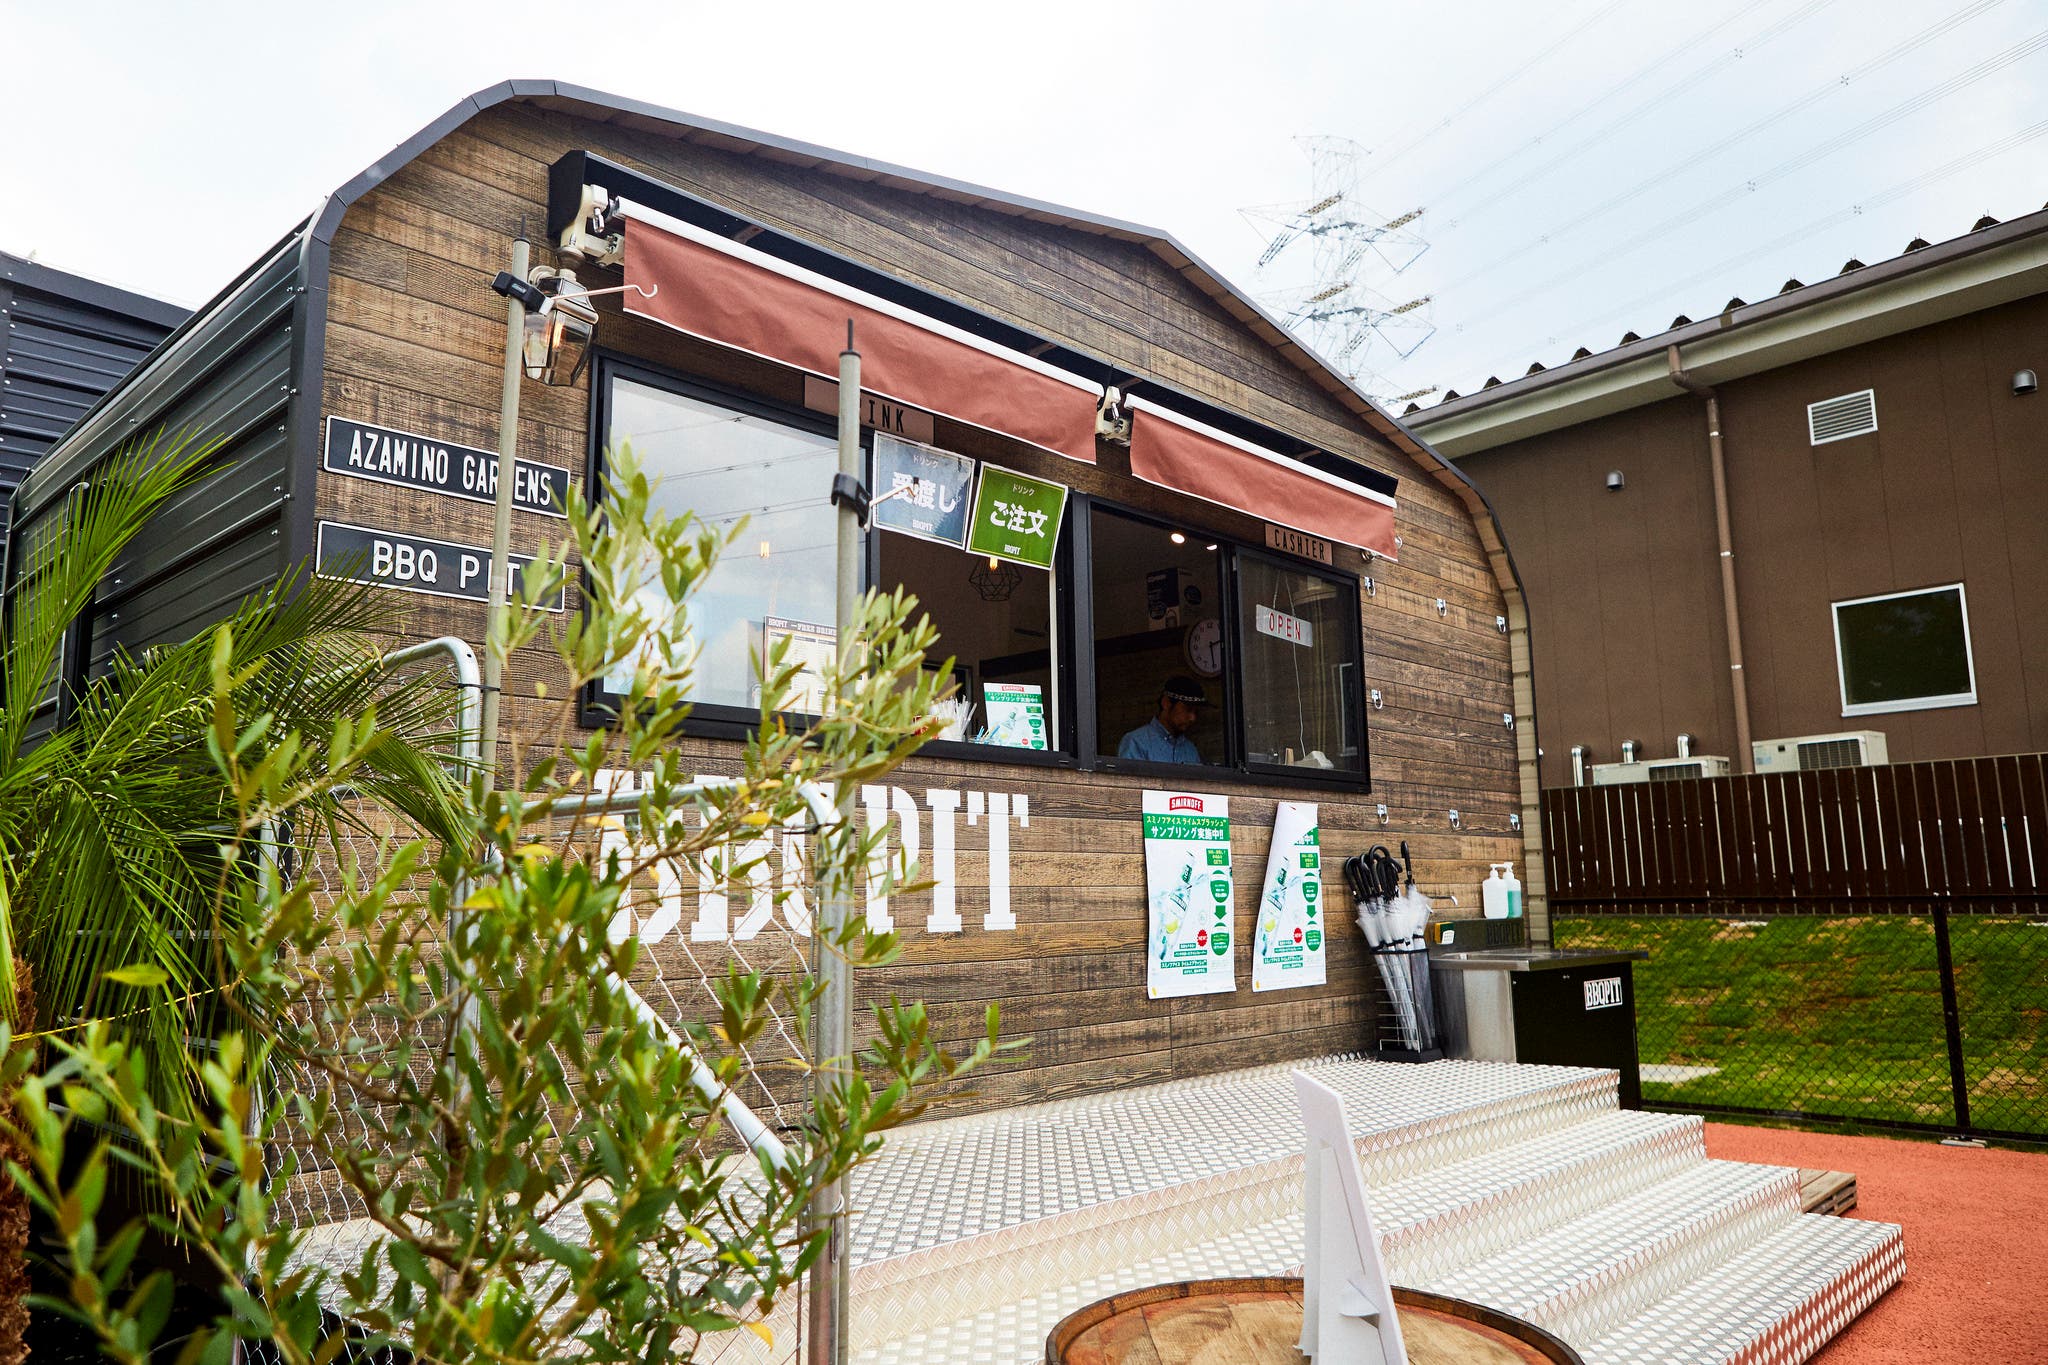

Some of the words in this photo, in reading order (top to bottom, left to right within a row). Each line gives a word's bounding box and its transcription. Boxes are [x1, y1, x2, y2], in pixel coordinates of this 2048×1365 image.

[349, 430, 449, 485] AZAMINO
[462, 455, 551, 505] GARENS
[913, 454, 939, 469] ドリンク
[1013, 483, 1035, 497] ドリンク
[990, 500, 1049, 538] ご注文
[1274, 528, 1325, 561] CASHIER
[372, 540, 438, 584] BBQ
[1268, 612, 1301, 641] OPEN
[1171, 797, 1202, 810] SMIRNOFF
[1586, 979, 1621, 1006] BBQPIT
